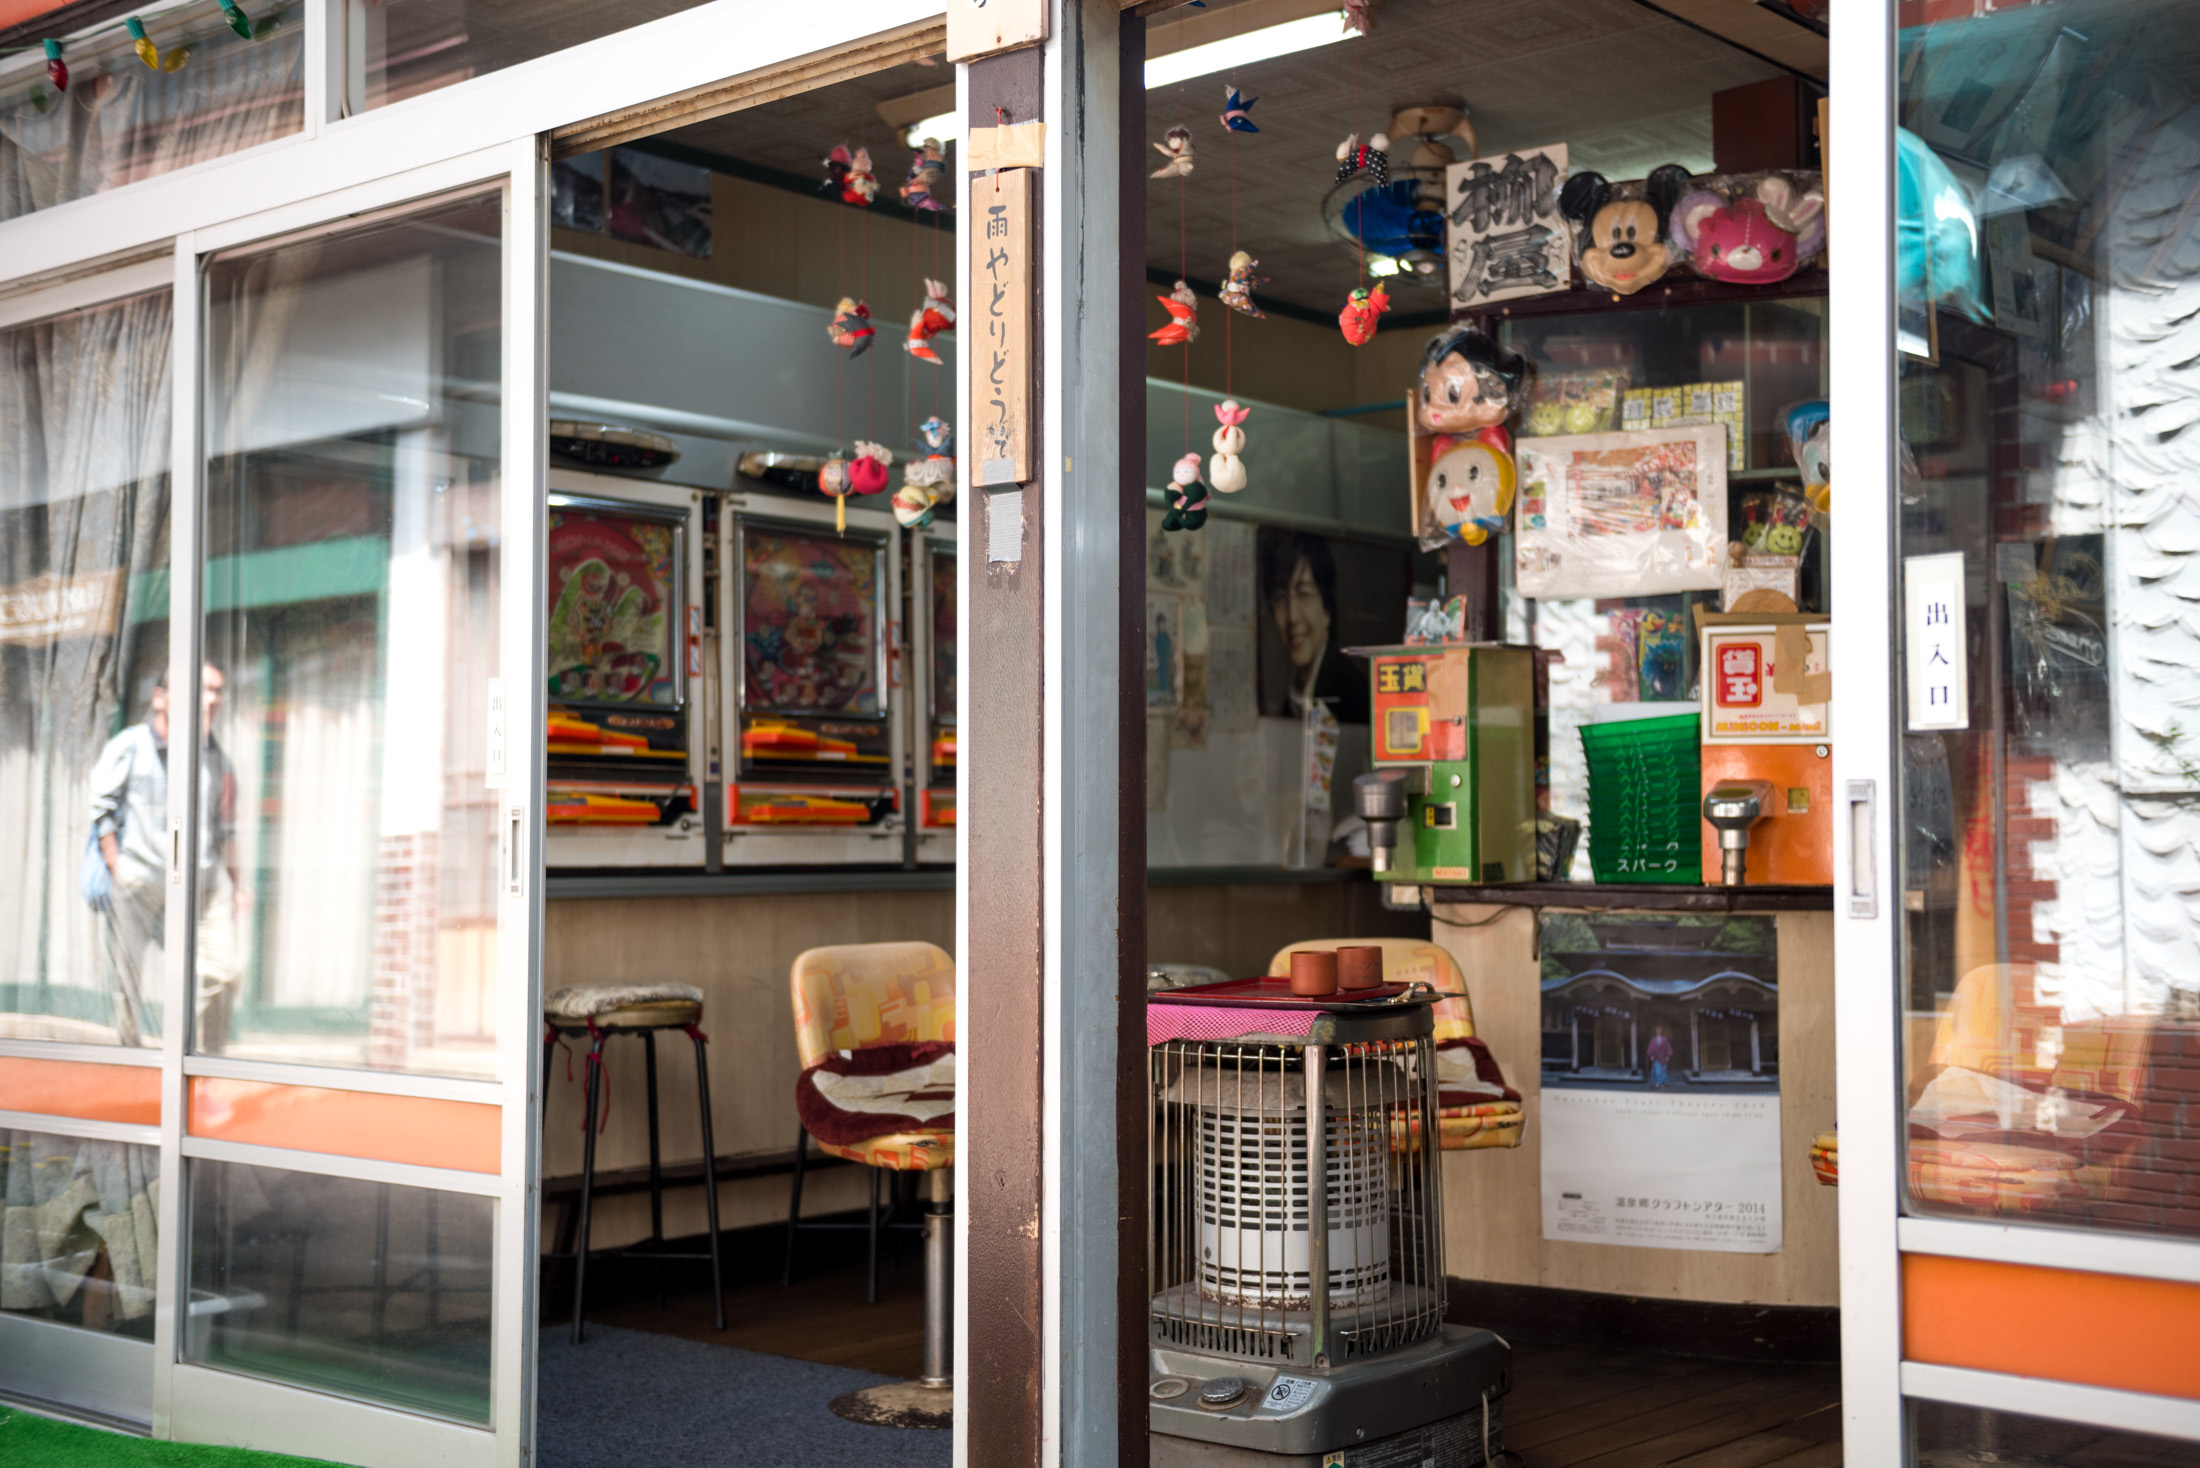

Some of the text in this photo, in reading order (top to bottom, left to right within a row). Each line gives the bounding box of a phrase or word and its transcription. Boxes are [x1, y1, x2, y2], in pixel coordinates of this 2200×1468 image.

[1927, 602, 1949, 706] 出入口
[1617, 859, 1677, 873] スパーク
[1738, 1201, 1766, 1214] 2014
